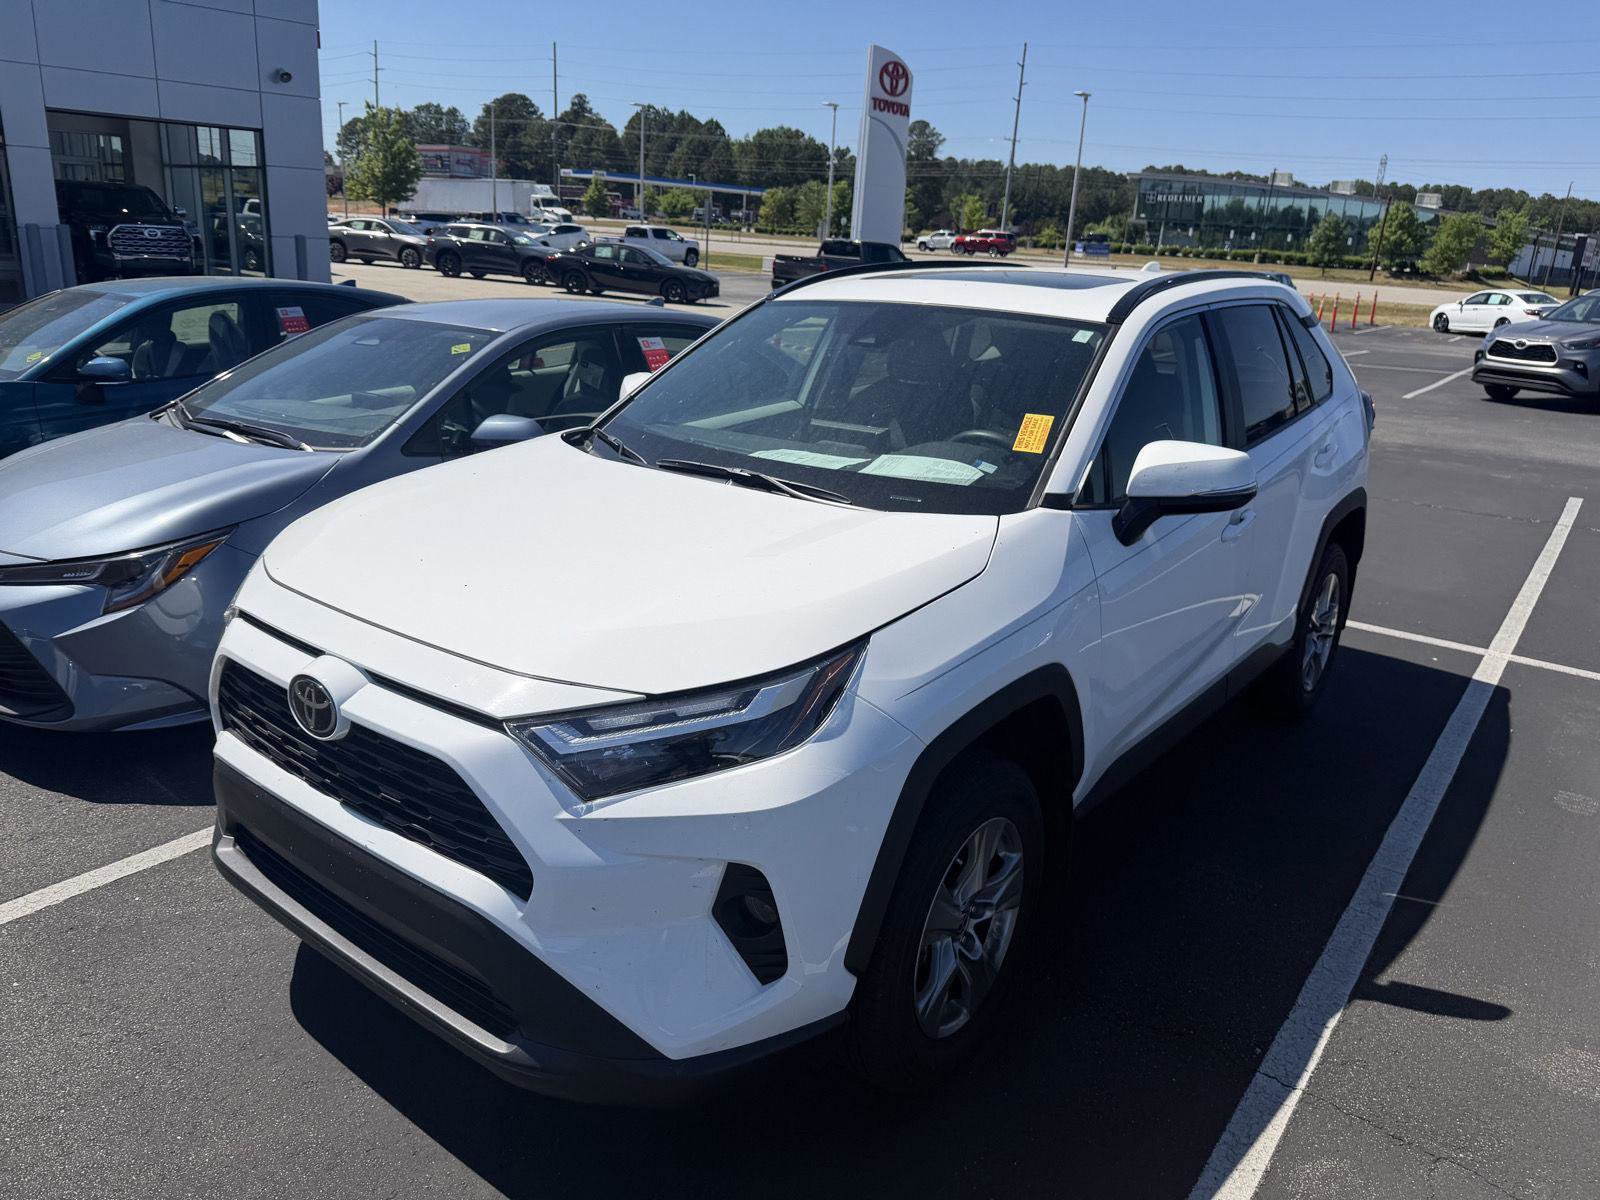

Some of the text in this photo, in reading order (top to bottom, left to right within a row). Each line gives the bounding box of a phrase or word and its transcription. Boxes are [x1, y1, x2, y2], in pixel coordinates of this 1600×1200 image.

[872, 97, 909, 117] TOYOTA
[1157, 194, 1203, 203] REDEEMER
[1019, 416, 1033, 436] VEHICLE
